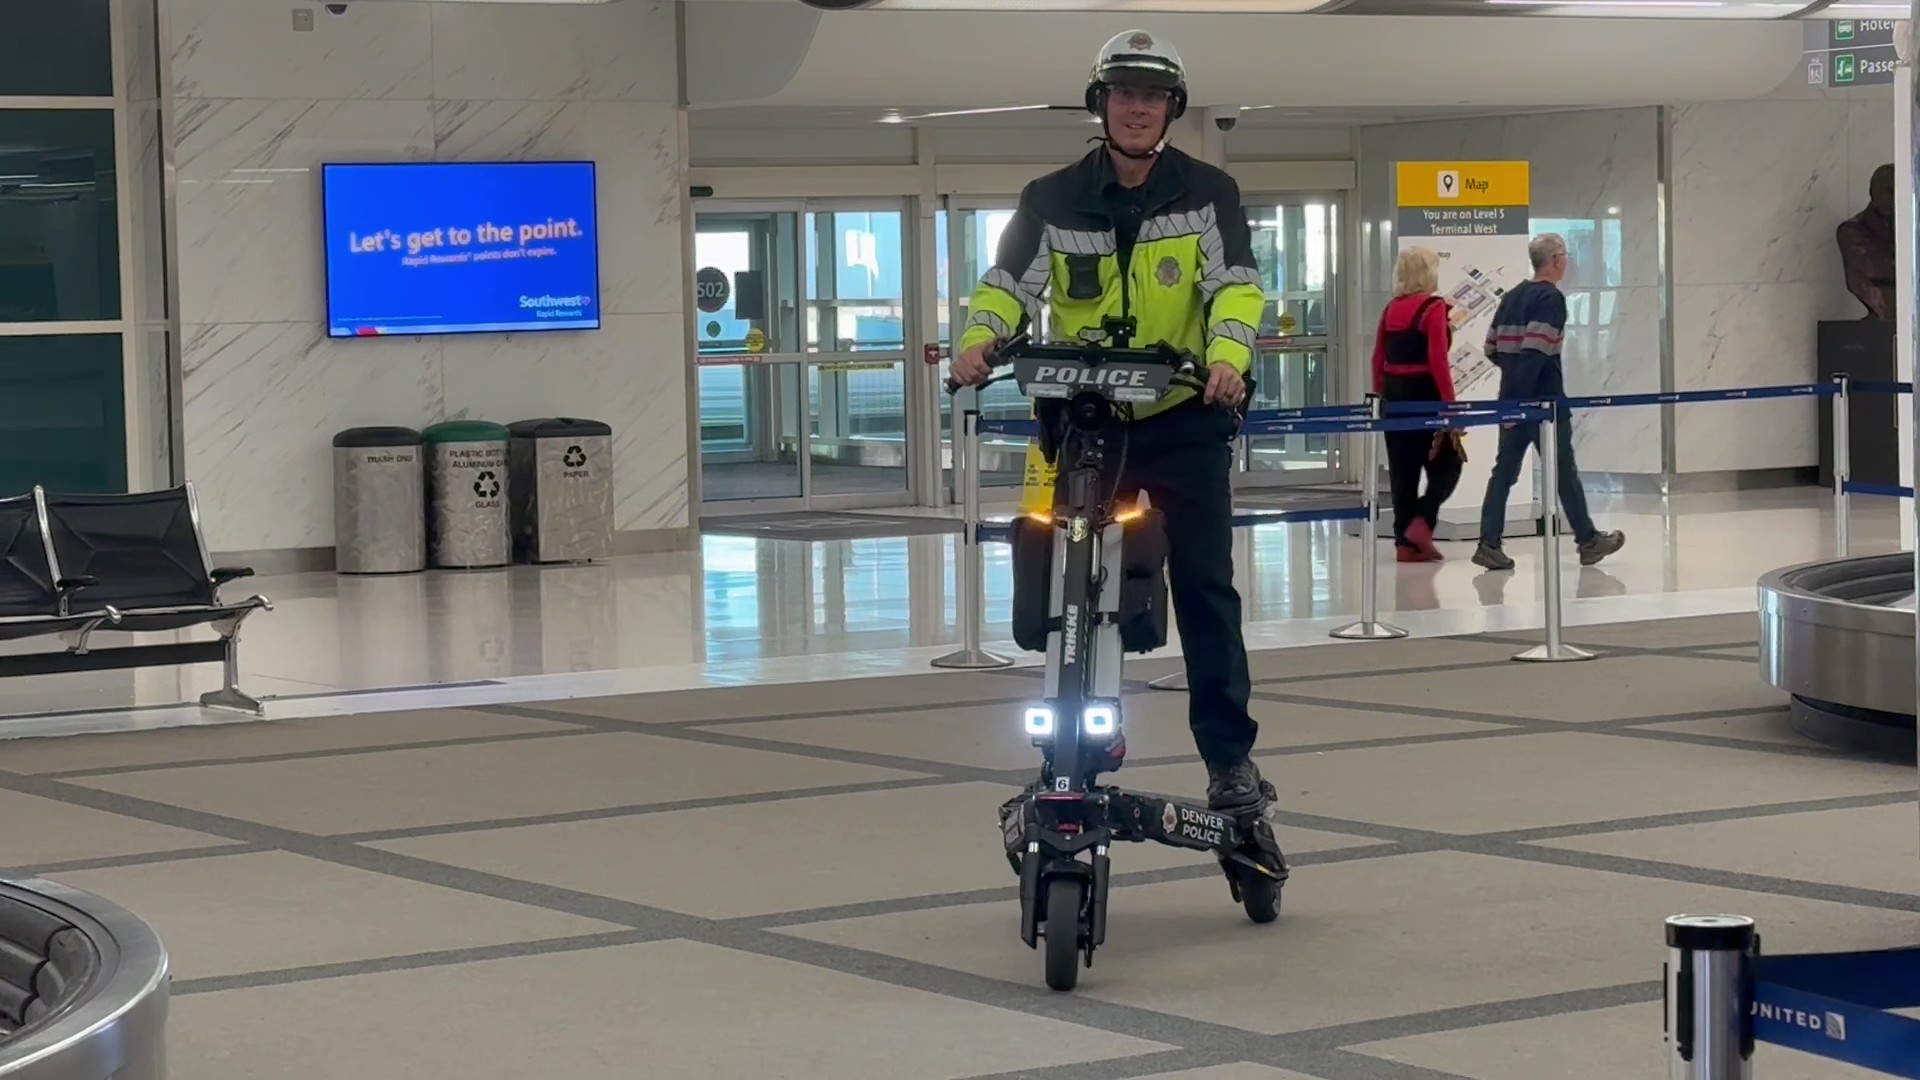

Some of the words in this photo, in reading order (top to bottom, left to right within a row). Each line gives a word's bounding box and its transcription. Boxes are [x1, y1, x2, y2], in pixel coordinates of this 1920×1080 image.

[1465, 178, 1489, 193] Map
[1423, 210, 1440, 220] You
[1442, 211, 1457, 219] are
[1459, 211, 1471, 219] on
[1474, 209, 1497, 219] Level
[1499, 209, 1504, 218] 5
[1431, 224, 1472, 234] Terminal
[1474, 223, 1497, 234] West
[350, 229, 401, 253] Let's
[407, 227, 444, 254] get
[448, 226, 471, 246] to
[477, 222, 513, 243] the
[519, 218, 583, 245] point.
[474, 251, 501, 262] points
[519, 295, 581, 308] Southwest
[1035, 366, 1148, 387] POLICE
[450, 450, 483, 458] PLASTIC
[563, 470, 589, 478] PAPER
[475, 500, 500, 508] GLASS
[1064, 604, 1079, 665] TRIKKE
[1058, 779, 1067, 790] 6
[1181, 808, 1224, 831] DENVER
[1182, 824, 1222, 845] POLICE
